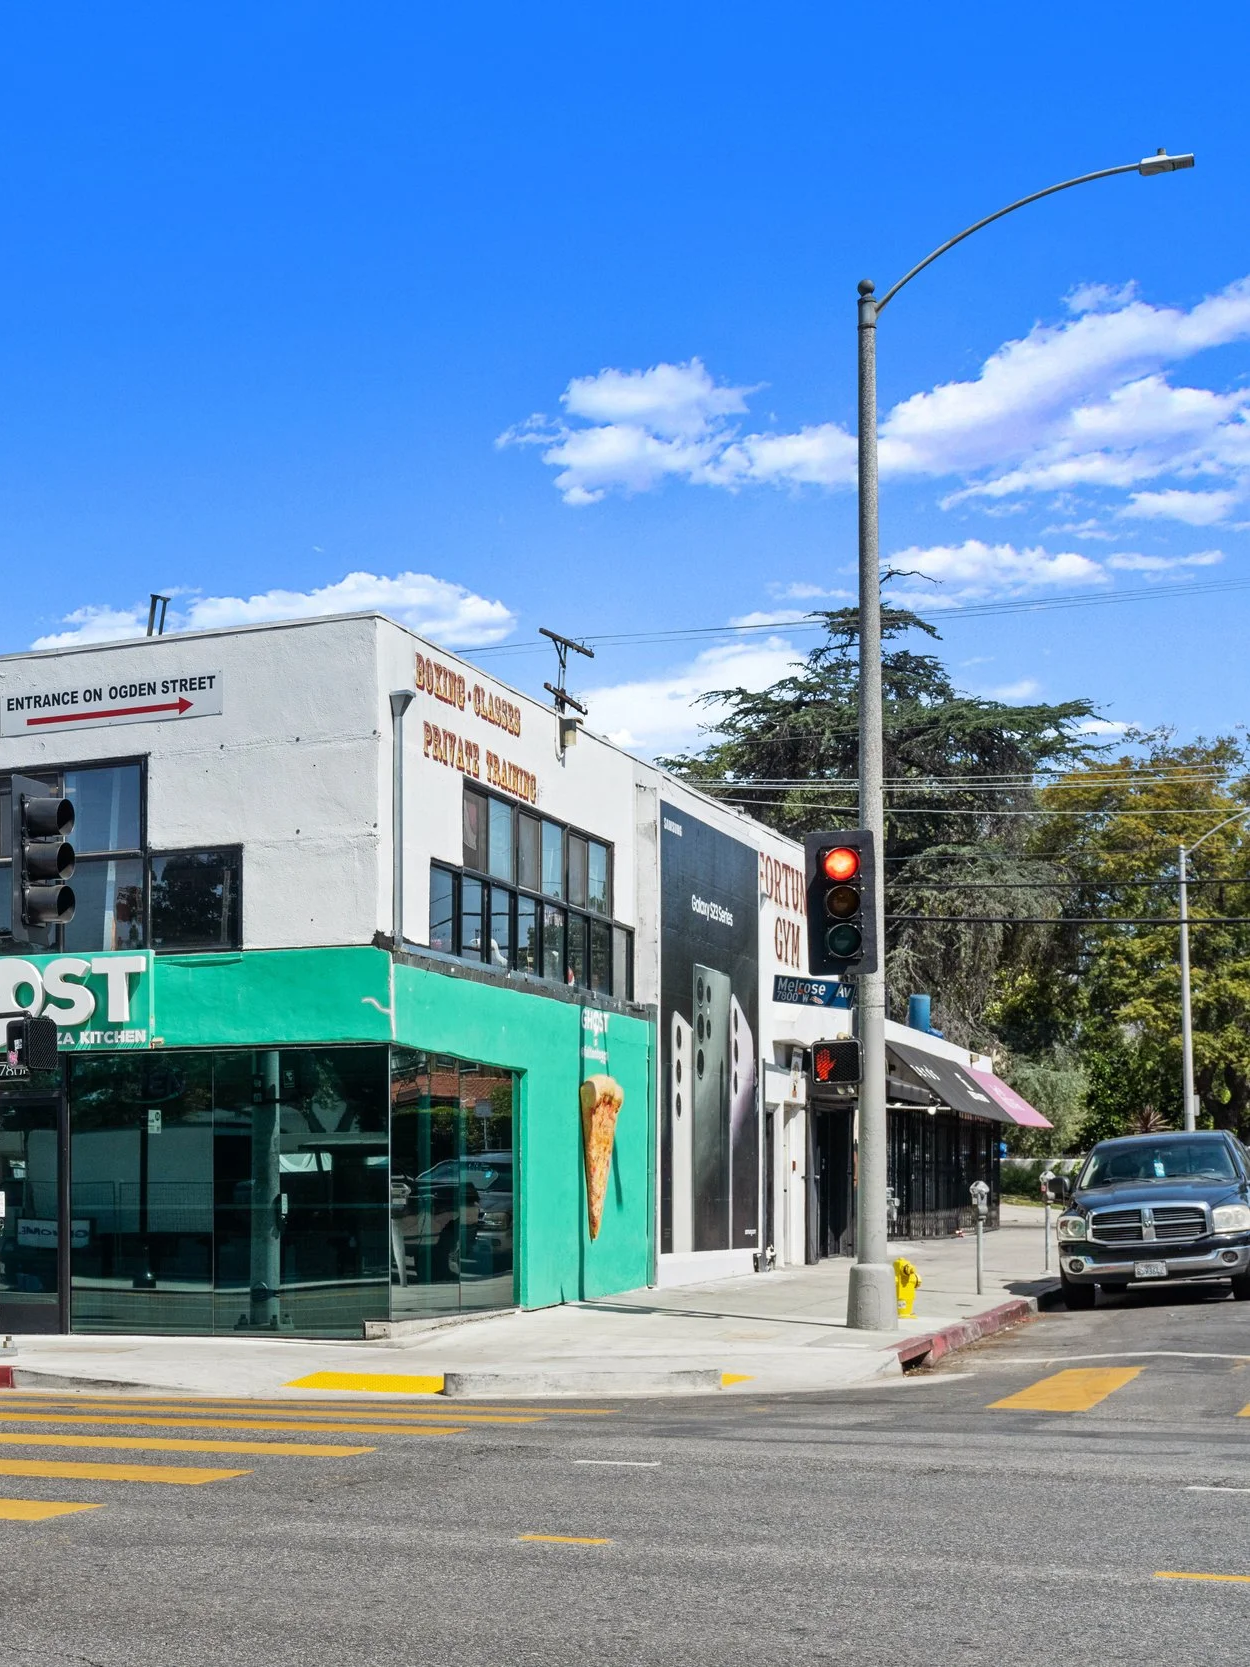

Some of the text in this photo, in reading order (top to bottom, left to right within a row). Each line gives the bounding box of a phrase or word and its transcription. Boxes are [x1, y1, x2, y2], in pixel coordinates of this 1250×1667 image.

[6, 675, 216, 712] ENTRANCE ON OGDEN STREET
[415, 652, 521, 738] BOXING CLASSES
[423, 720, 537, 805] PRIVATE TRAINING
[759, 851, 808, 917] ORTUN
[691, 894, 733, 927] Galaxy S23 Series
[774, 916, 800, 969] GYM
[776, 990, 810, 1002] 7800 W
[777, 977, 826, 995] Melrose
[79, 1029, 147, 1045] KITCHEN
